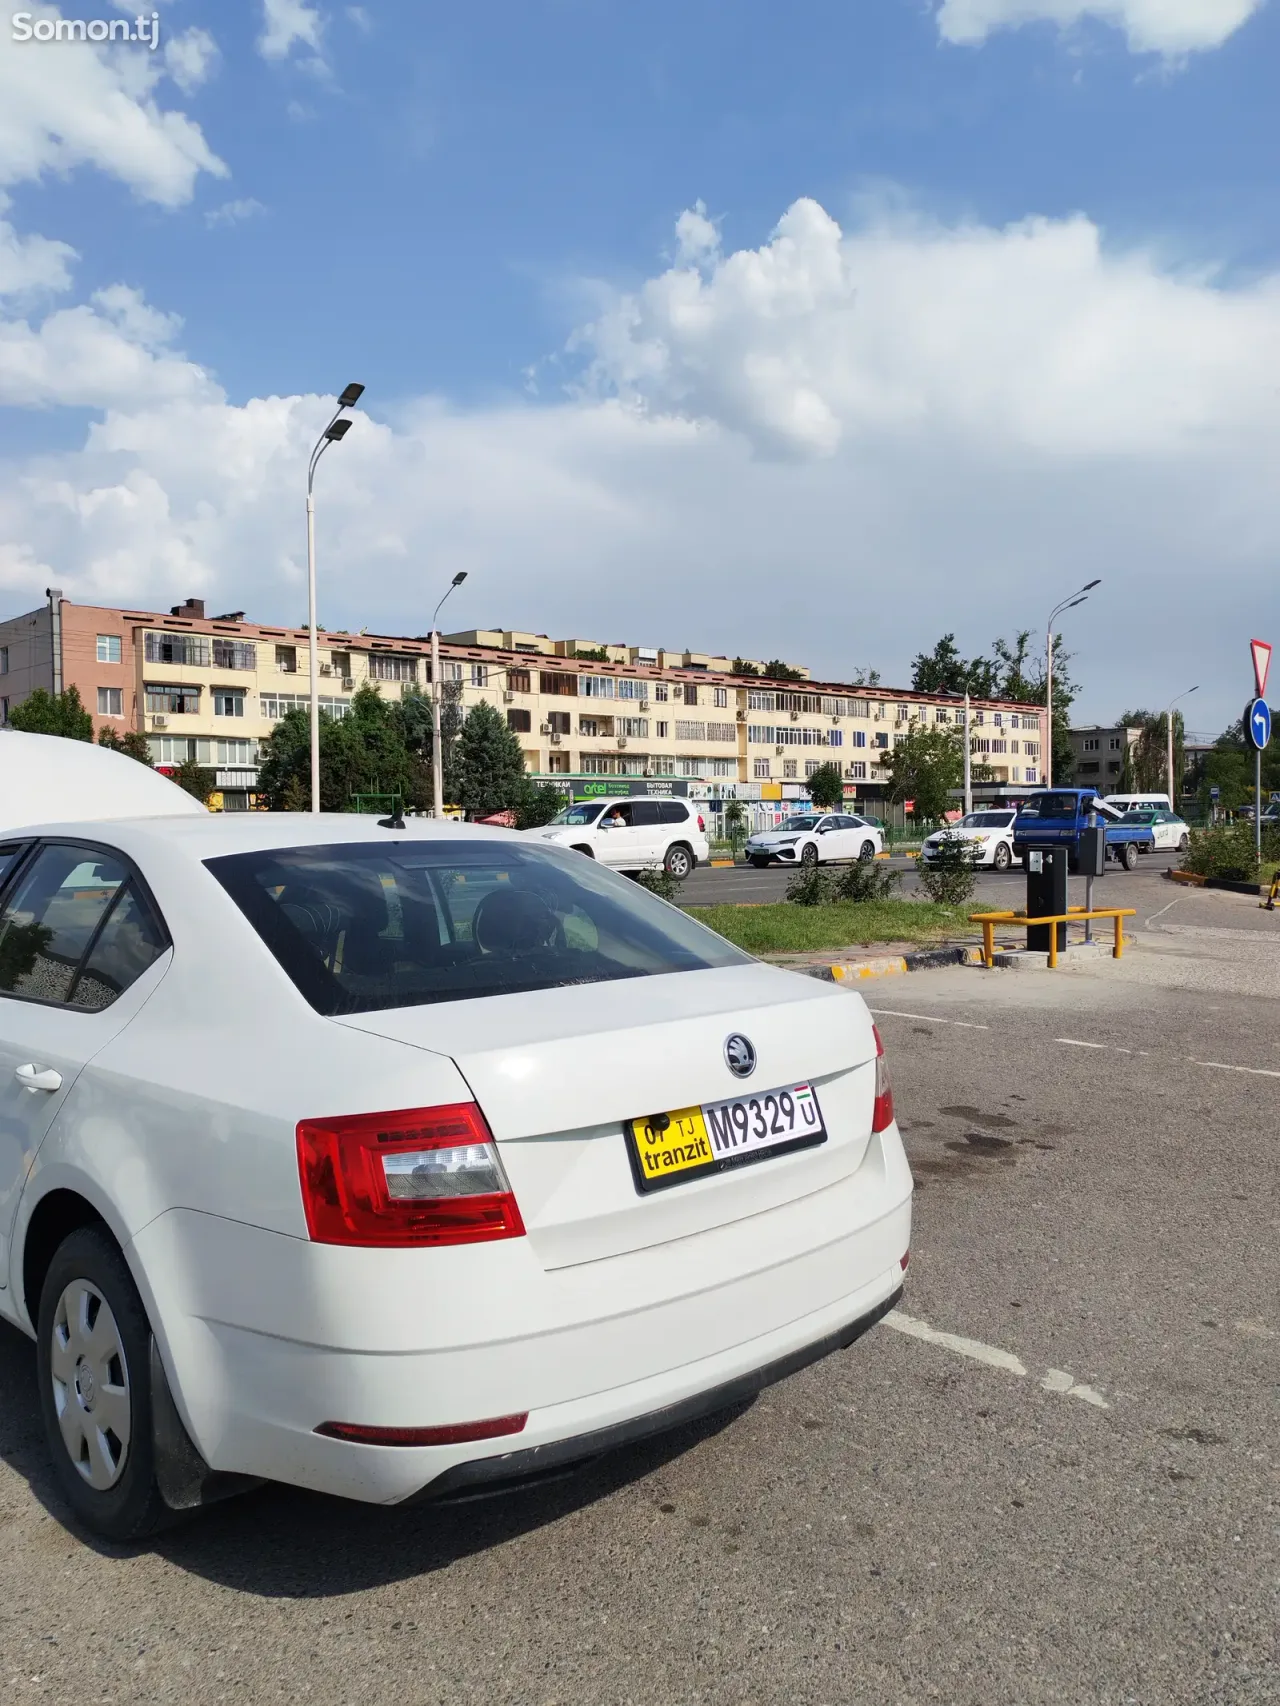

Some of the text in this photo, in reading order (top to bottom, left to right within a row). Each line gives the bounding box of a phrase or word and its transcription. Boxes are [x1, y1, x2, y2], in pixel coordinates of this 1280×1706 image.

[583, 782, 607, 795] artel
[675, 1117, 695, 1138] TJ
[706, 1091, 816, 1151] M9329 U
[644, 1136, 709, 1171] tranzit
